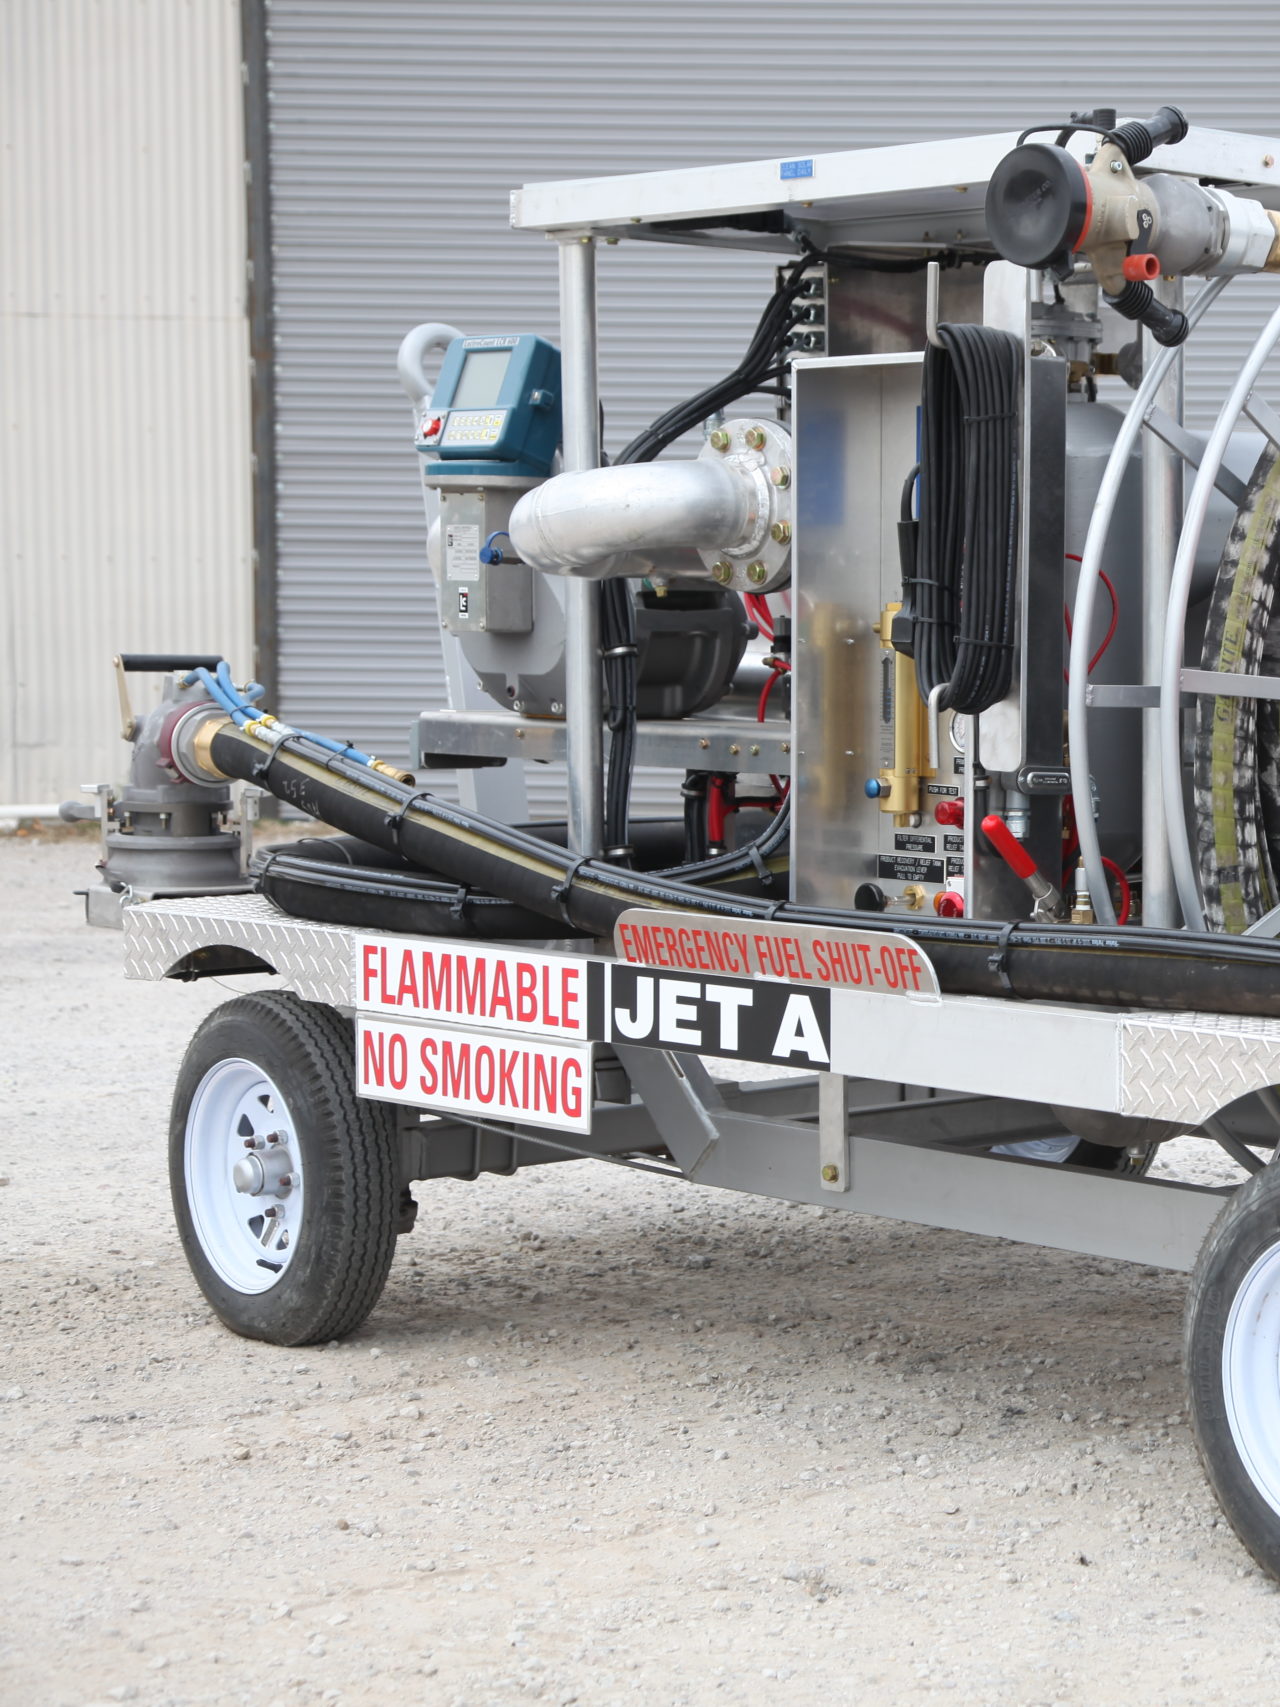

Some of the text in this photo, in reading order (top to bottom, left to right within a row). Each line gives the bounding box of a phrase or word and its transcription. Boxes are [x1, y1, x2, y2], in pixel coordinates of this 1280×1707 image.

[1216, 629, 1241, 722] GASITE
[363, 944, 580, 1029] FLAMMABLE
[618, 923, 922, 990] EMERGENCY FUEL SHUT-OFF
[614, 976, 830, 1064] JET A
[363, 1029, 582, 1118] NO SMOKING
